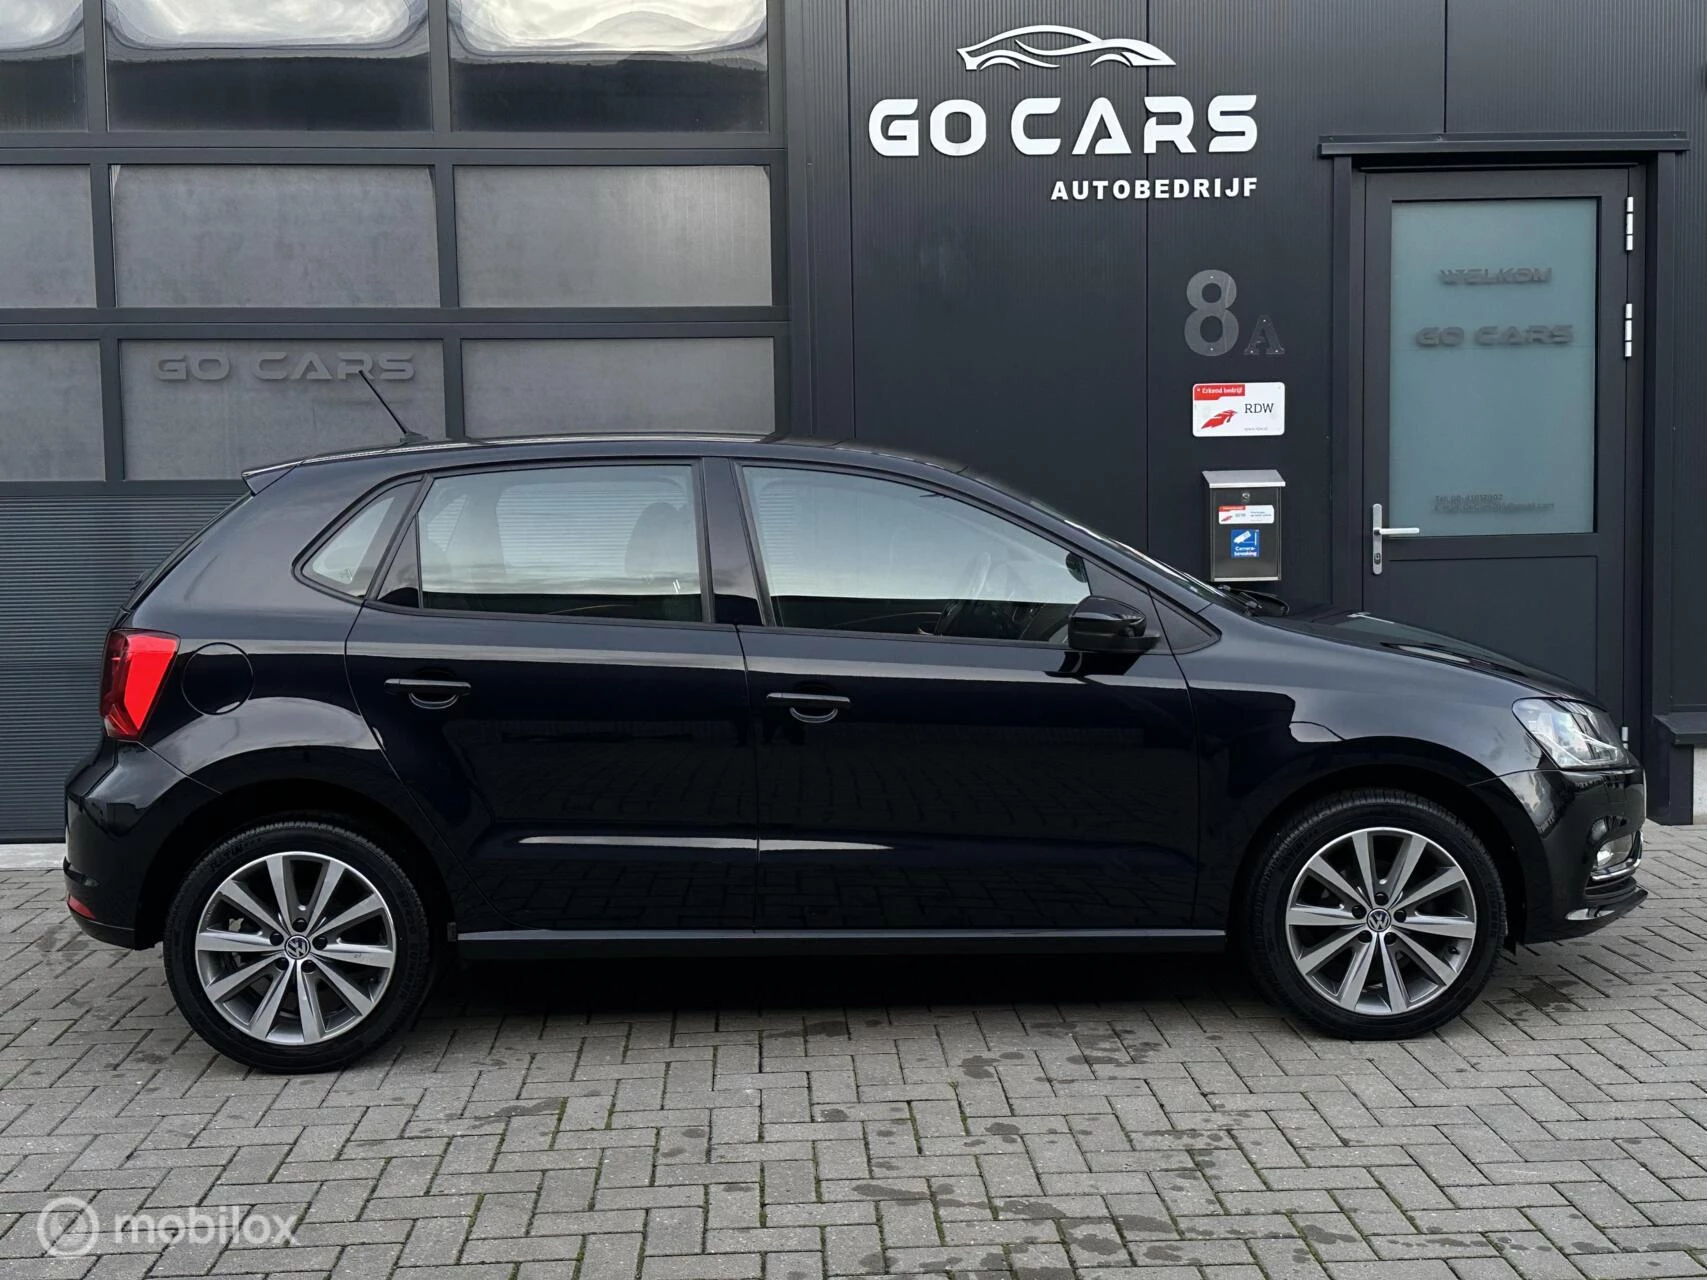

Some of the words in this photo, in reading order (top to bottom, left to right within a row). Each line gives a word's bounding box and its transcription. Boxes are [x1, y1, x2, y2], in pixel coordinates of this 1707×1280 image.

[868, 98, 987, 157] GO
[1010, 94, 1258, 156] CARS
[1050, 176, 1258, 200] AUTOBEDRIJF
[1439, 267, 1552, 286] WELKOM
[1415, 327, 1464, 348] GO
[1475, 325, 1573, 346] CARS
[154, 352, 231, 381] GO
[253, 351, 415, 381] CARS
[1244, 403, 1275, 414] RDW
